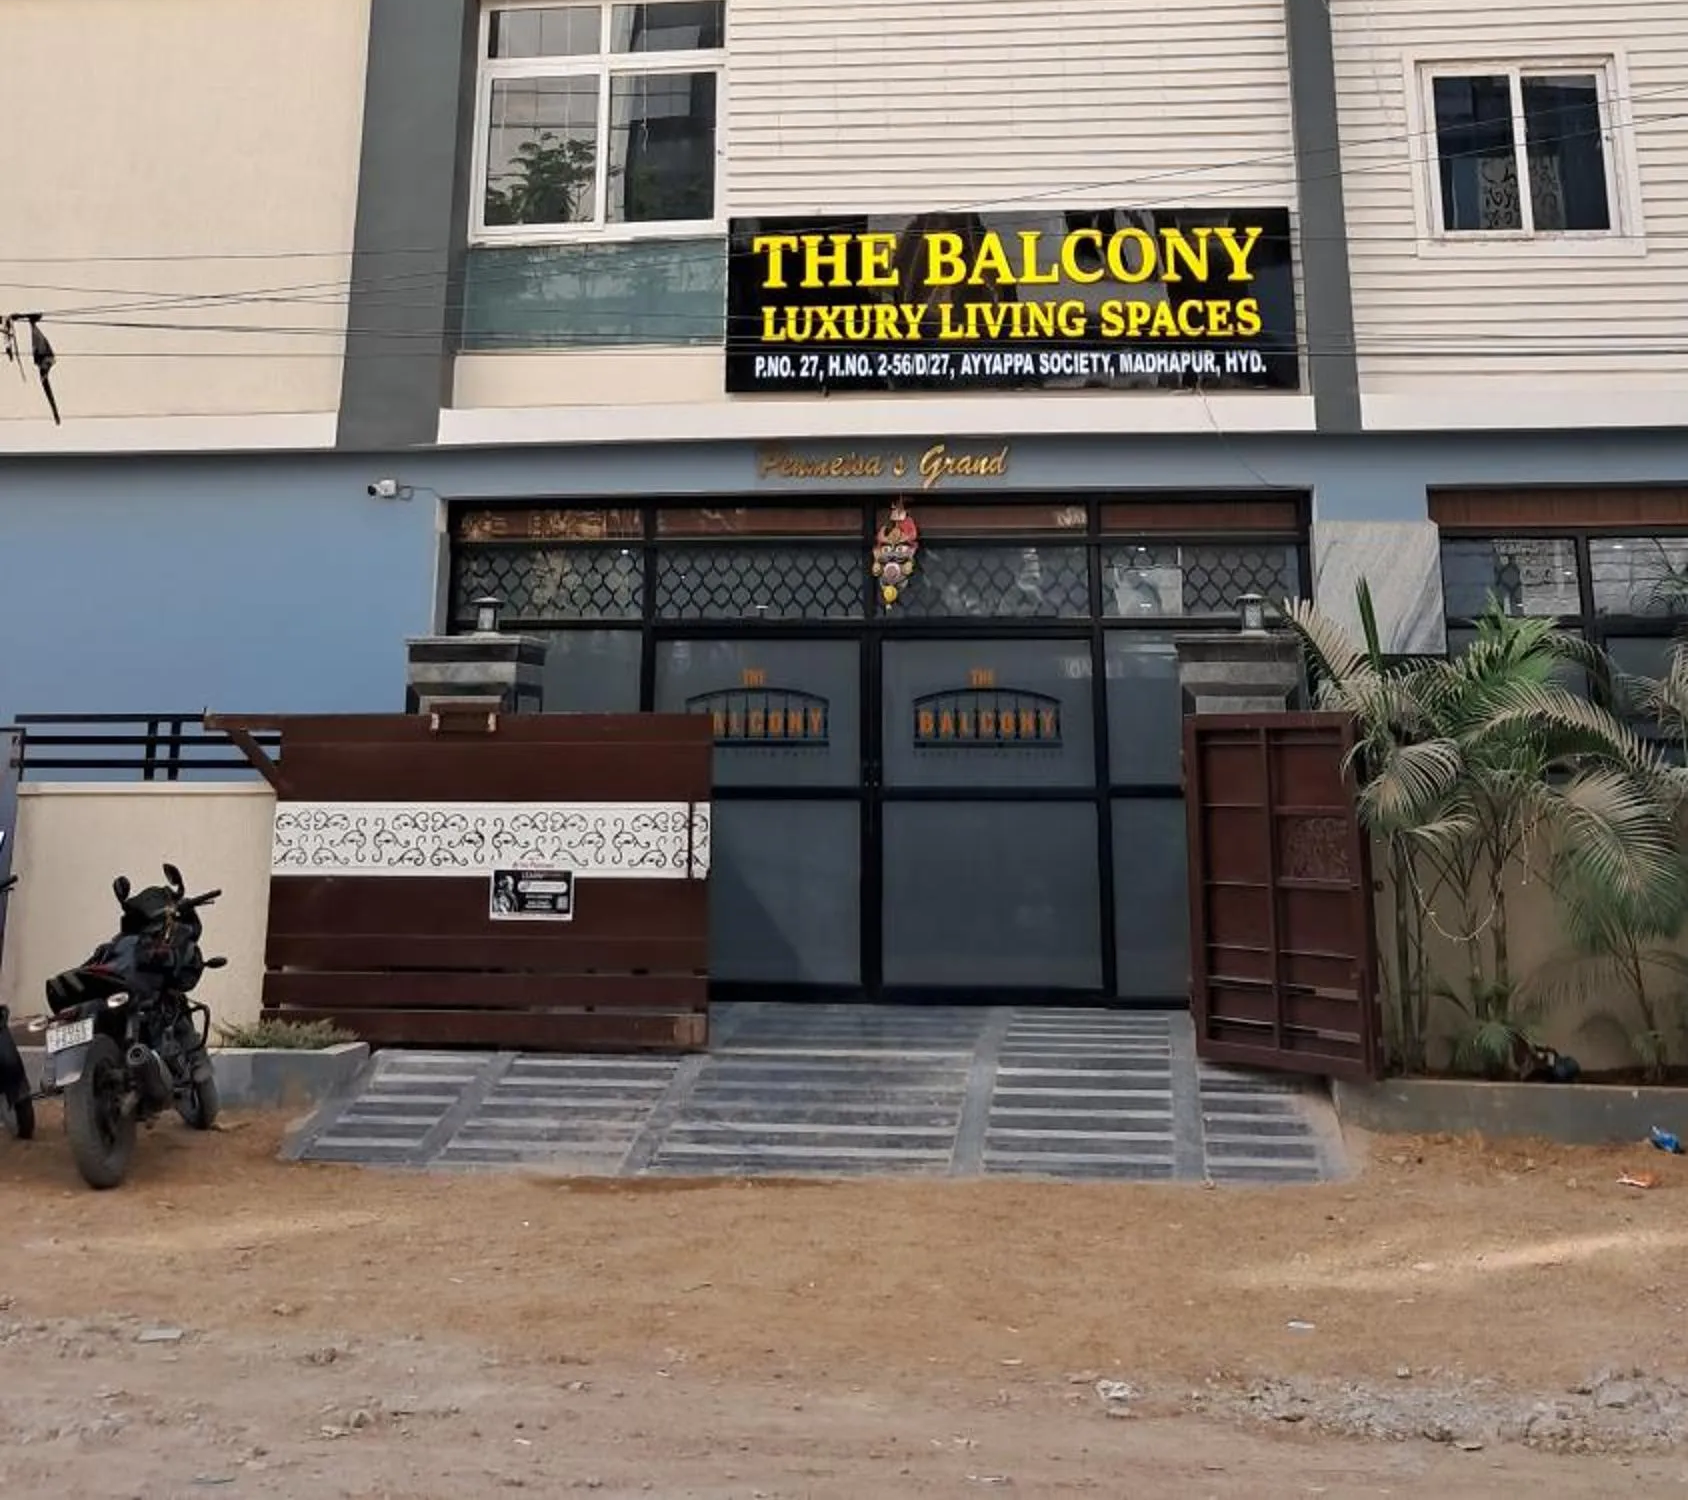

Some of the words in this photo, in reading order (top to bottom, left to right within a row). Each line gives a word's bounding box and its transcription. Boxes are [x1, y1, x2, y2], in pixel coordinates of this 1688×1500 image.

[753, 232, 900, 289] THE
[923, 226, 1262, 287] BALCONY
[762, 303, 927, 342] LUXURY
[938, 299, 1087, 340] LIVING
[1100, 297, 1263, 337] SPACES
[755, 355, 795, 378] P.NO.
[799, 355, 825, 381] 27,
[828, 354, 873, 377] H.NO.
[878, 353, 956, 379] 2-56/D/27,
[960, 353, 1035, 375] AYYAPPA
[1039, 352, 1116, 378] SOCIETY,
[1119, 350, 1221, 377] MADHAPUR,
[1225, 351, 1267, 373] HYD.
[918, 443, 1008, 489] Grand
[742, 668, 766, 687] THE
[970, 668, 995, 687] THE
[713, 706, 822, 737] ALCONY
[918, 706, 1055, 737] BALCONY
